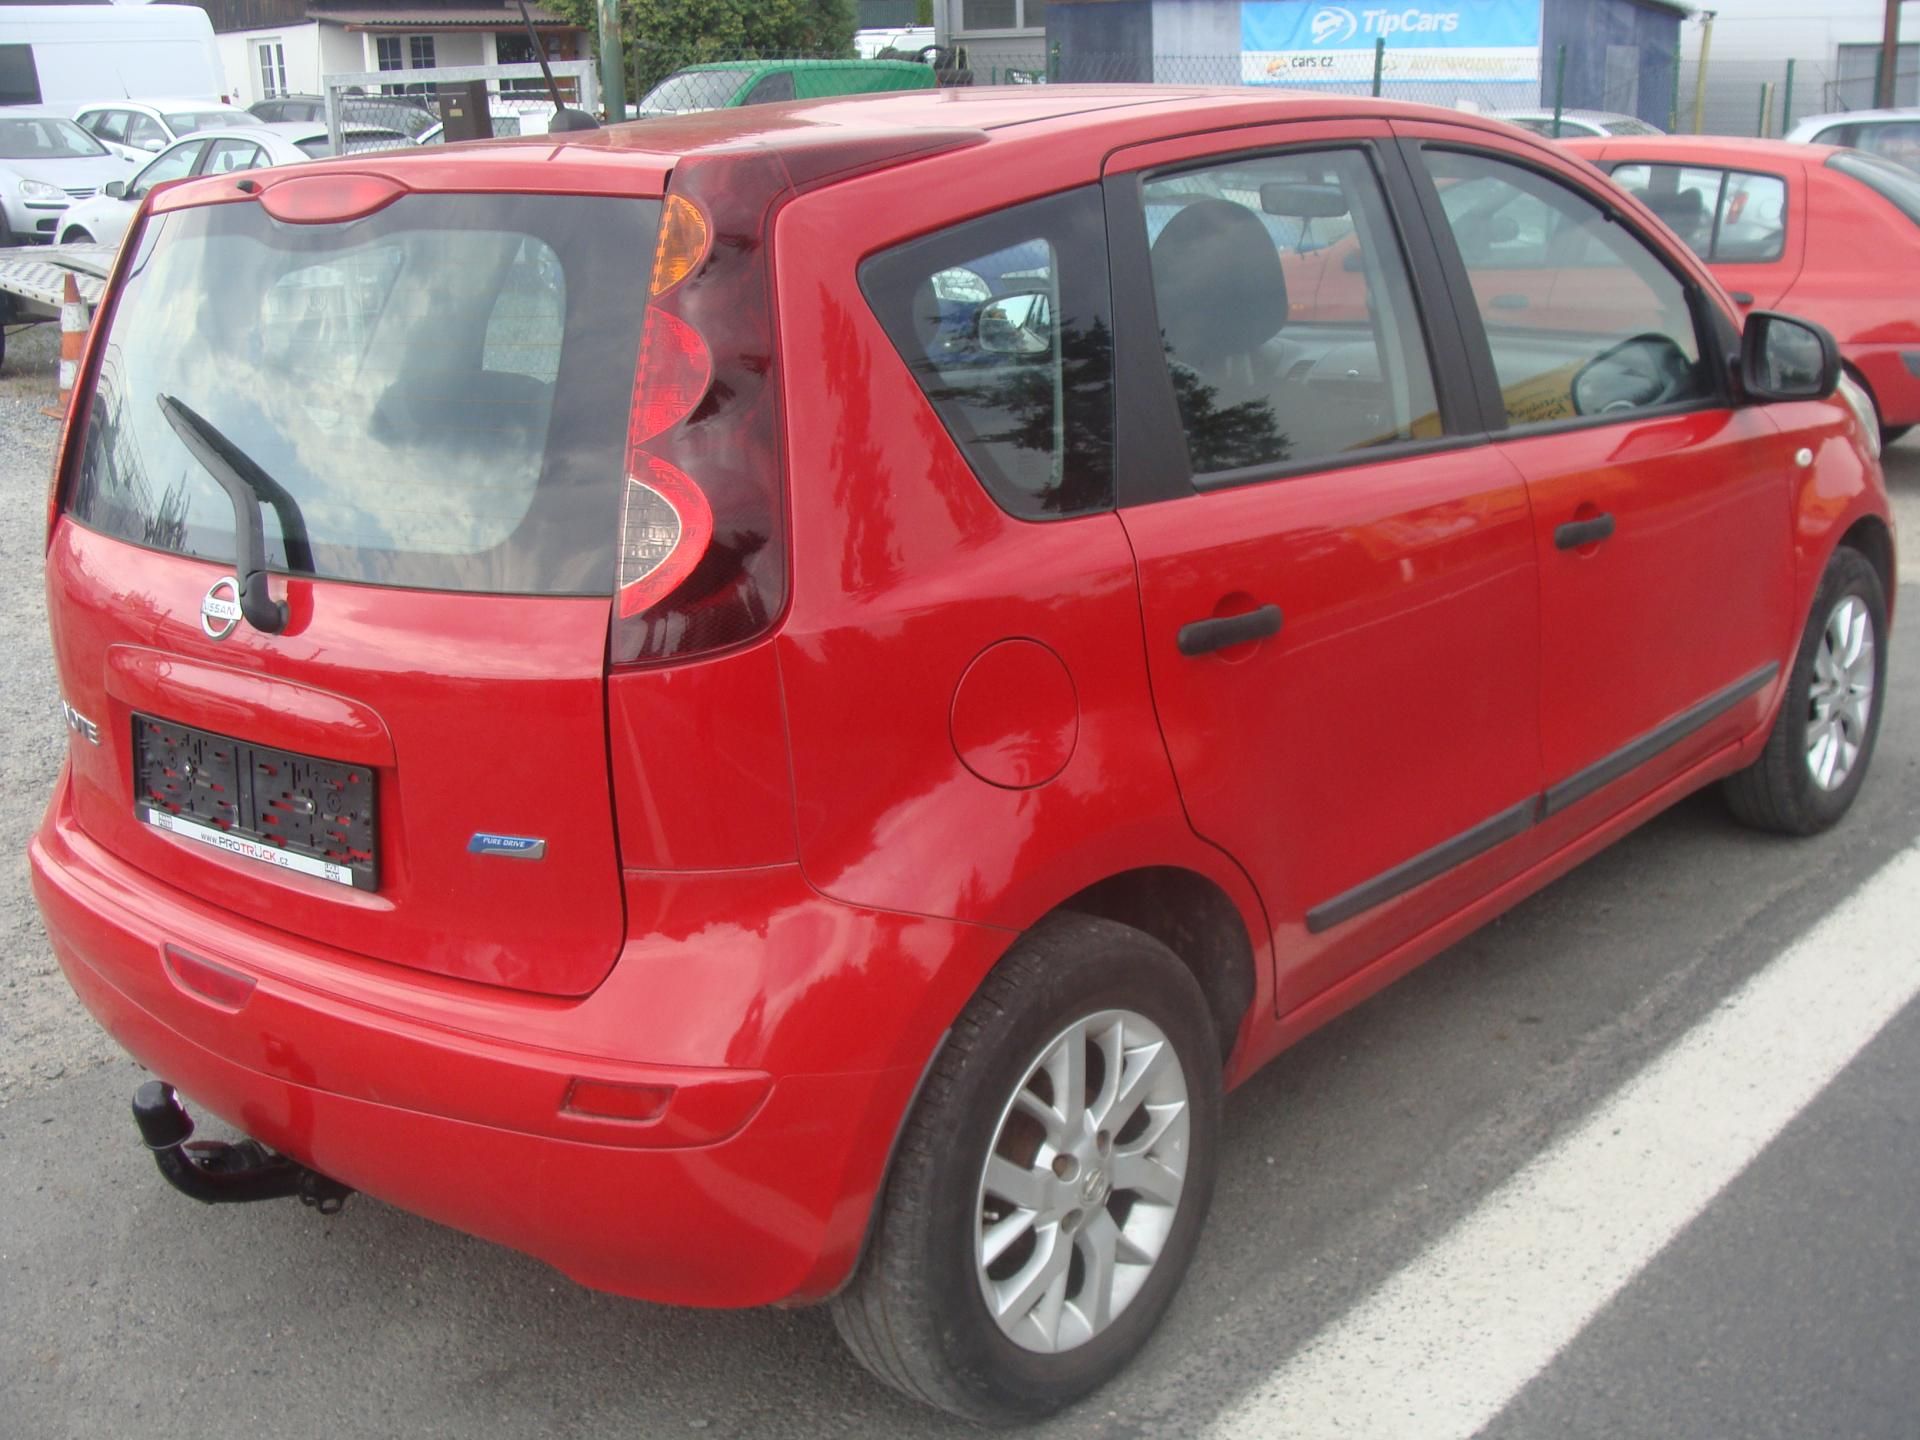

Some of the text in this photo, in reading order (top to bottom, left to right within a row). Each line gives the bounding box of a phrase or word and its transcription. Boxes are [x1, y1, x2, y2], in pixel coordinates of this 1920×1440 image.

[1362, 8, 1459, 37] TipCars
[482, 837, 526, 848] PURE DRIVE
